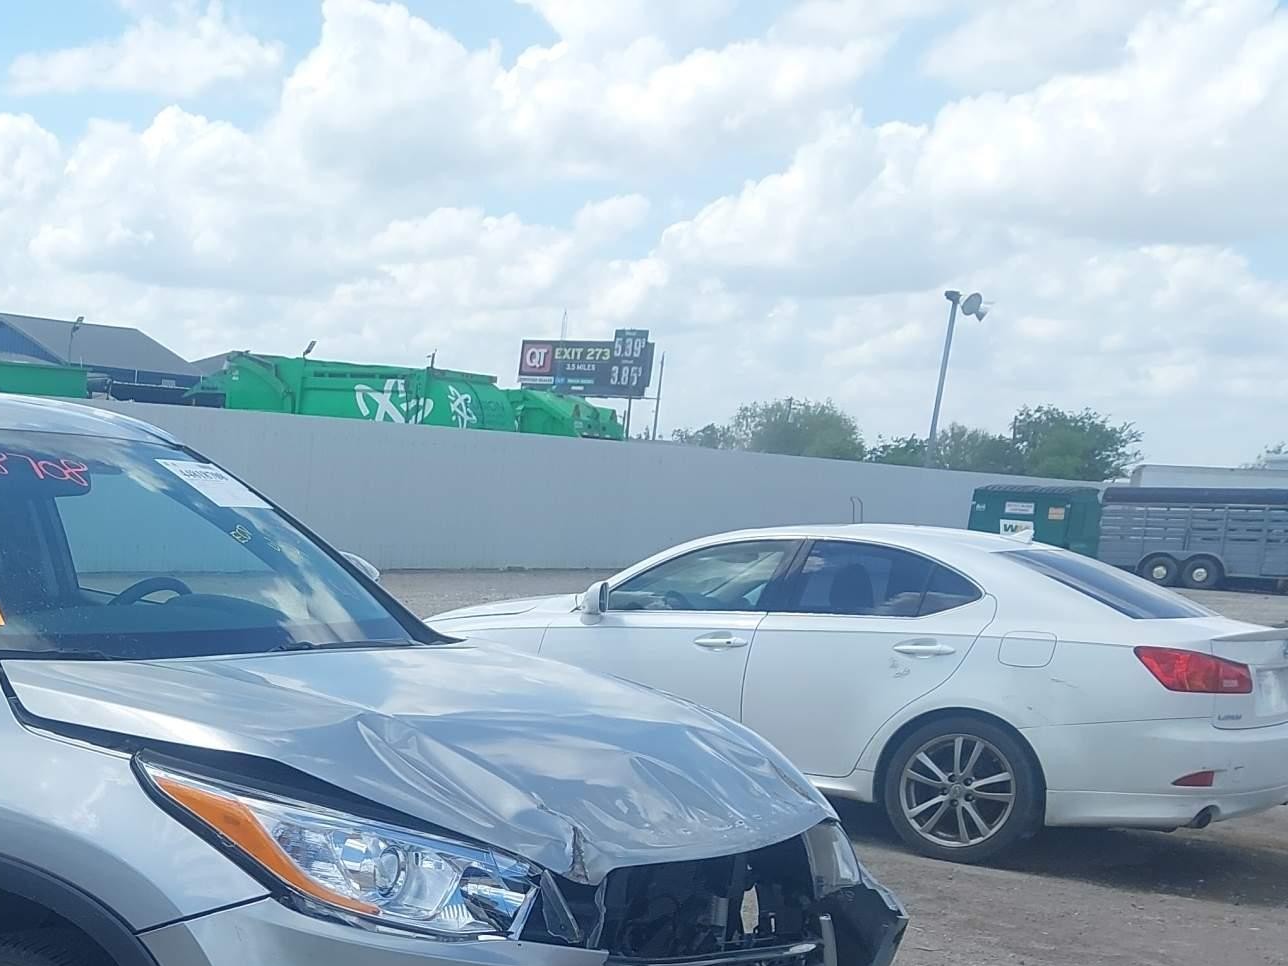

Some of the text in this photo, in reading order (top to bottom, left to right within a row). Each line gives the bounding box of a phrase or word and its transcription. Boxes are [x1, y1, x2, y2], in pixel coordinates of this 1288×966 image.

[526, 348, 548, 368] QT
[554, 347, 611, 360] EXIT 273
